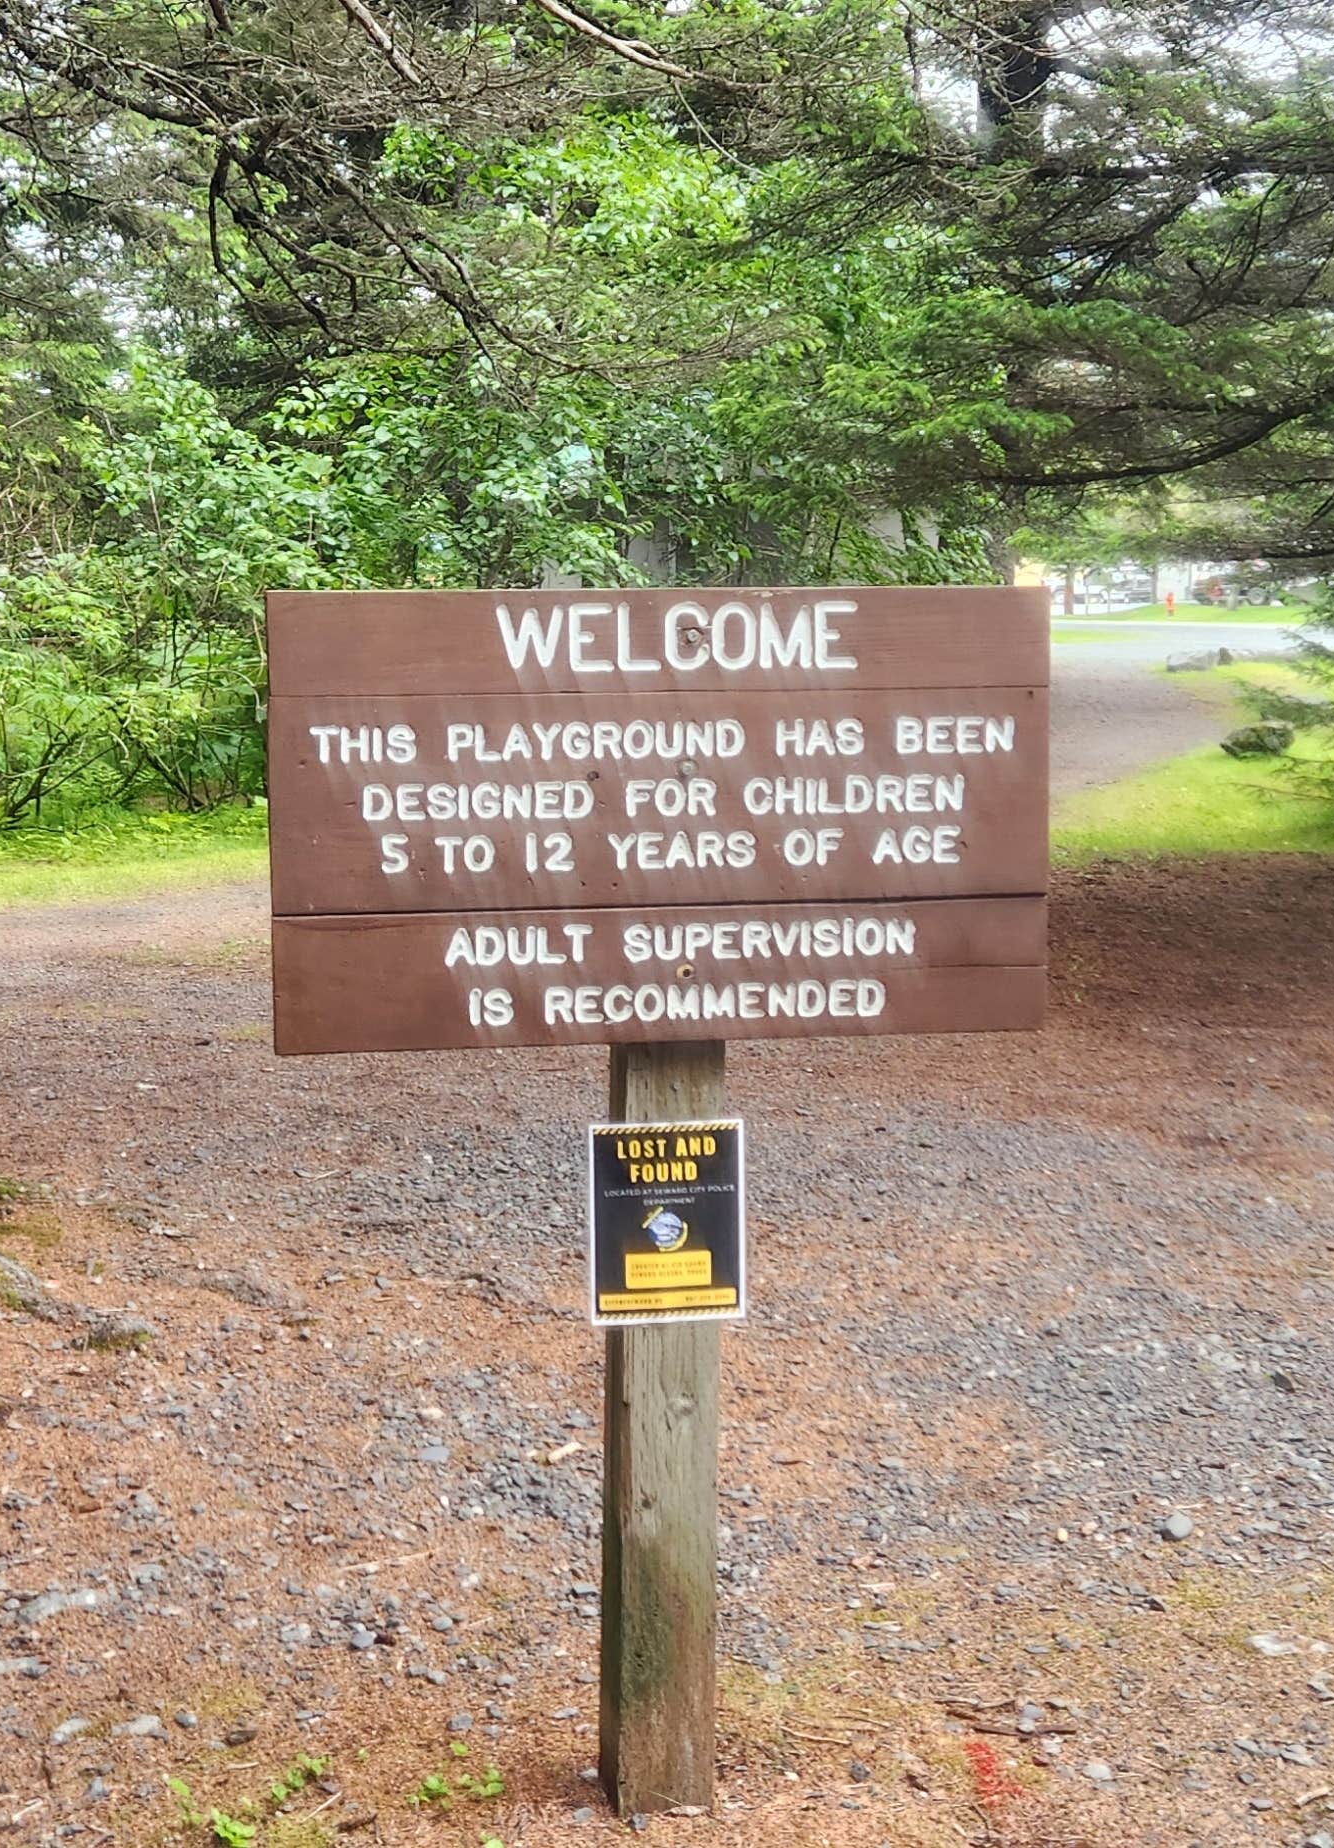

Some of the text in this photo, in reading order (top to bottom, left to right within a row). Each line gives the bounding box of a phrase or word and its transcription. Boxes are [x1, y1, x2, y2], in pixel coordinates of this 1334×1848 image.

[495, 599, 859, 675] WELCOME
[310, 715, 1015, 764] THIS PLAYGROUND HAS BEEN
[362, 774, 965, 821] DESIGNED FOR CHILDREN
[380, 825, 961, 874] 5 TO 12 YEARS OF AGE
[444, 918, 916, 968] ADULT SUPERVISION
[468, 979, 886, 1027] IS RECOMMENDED
[616, 1136, 717, 1159] LOST AND
[630, 1162, 698, 1183] FOUND
[707, 1184, 735, 1192] POLICE
